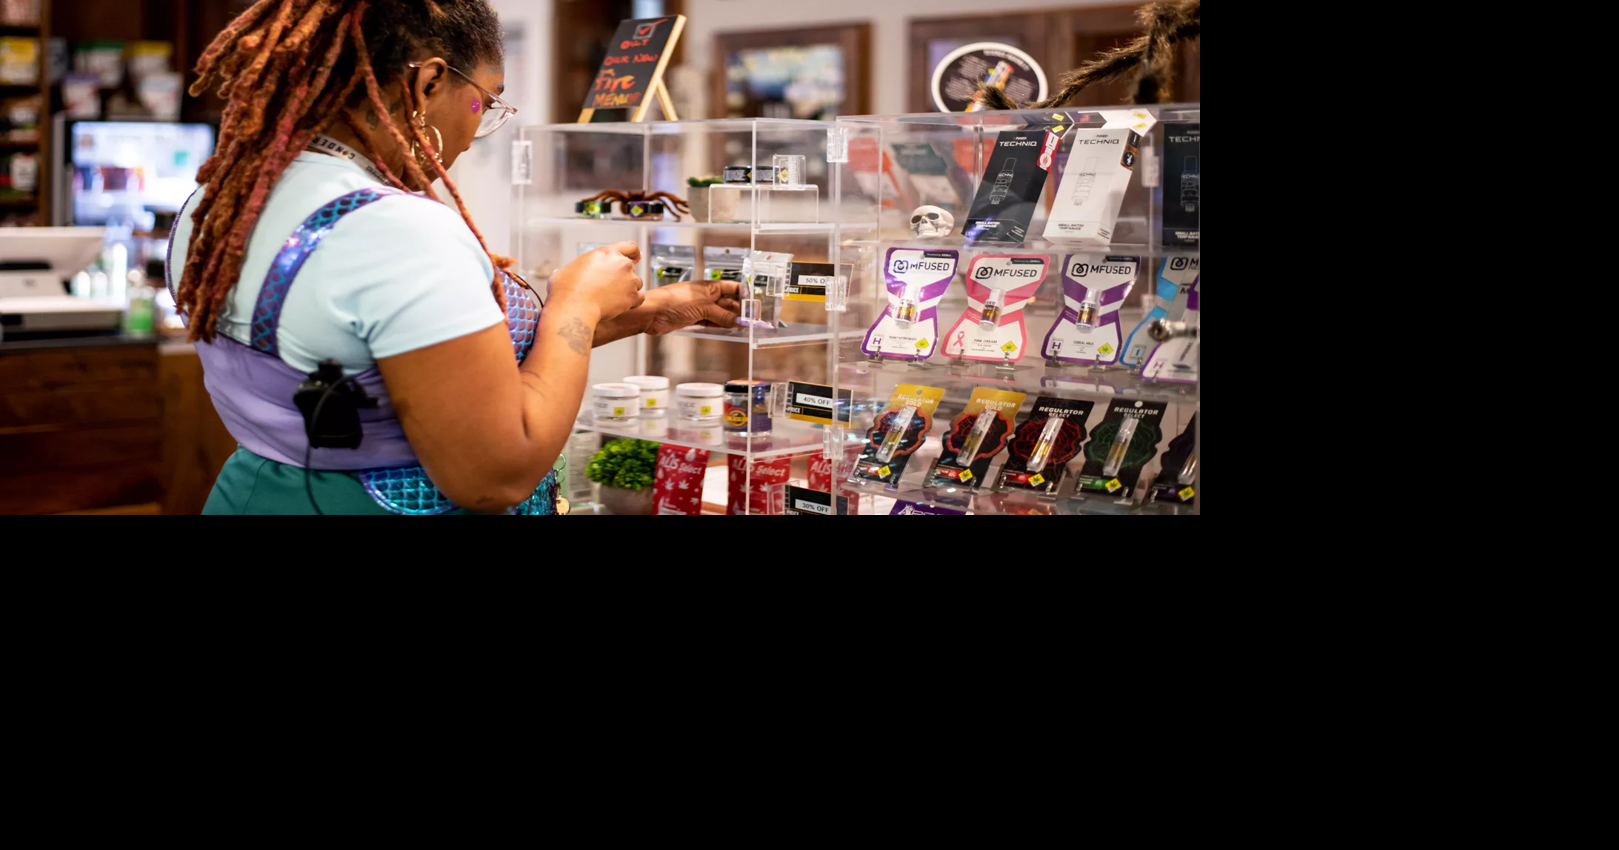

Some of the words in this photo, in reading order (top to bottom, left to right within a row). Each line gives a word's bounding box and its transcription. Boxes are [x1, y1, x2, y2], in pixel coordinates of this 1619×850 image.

[910, 261, 950, 271] MFUSED
[1090, 265, 1132, 275] MFUSED
[994, 269, 1038, 278] MFUSED
[872, 337, 882, 345] H
[1051, 341, 1061, 350] H
[898, 393, 934, 404] REGULATOR
[976, 398, 1016, 408] REGULATOR
[1039, 406, 1084, 415] REGULATOR
[1114, 406, 1159, 415] REGULATOR
[678, 462, 702, 474] Select
[756, 465, 786, 477] Select
